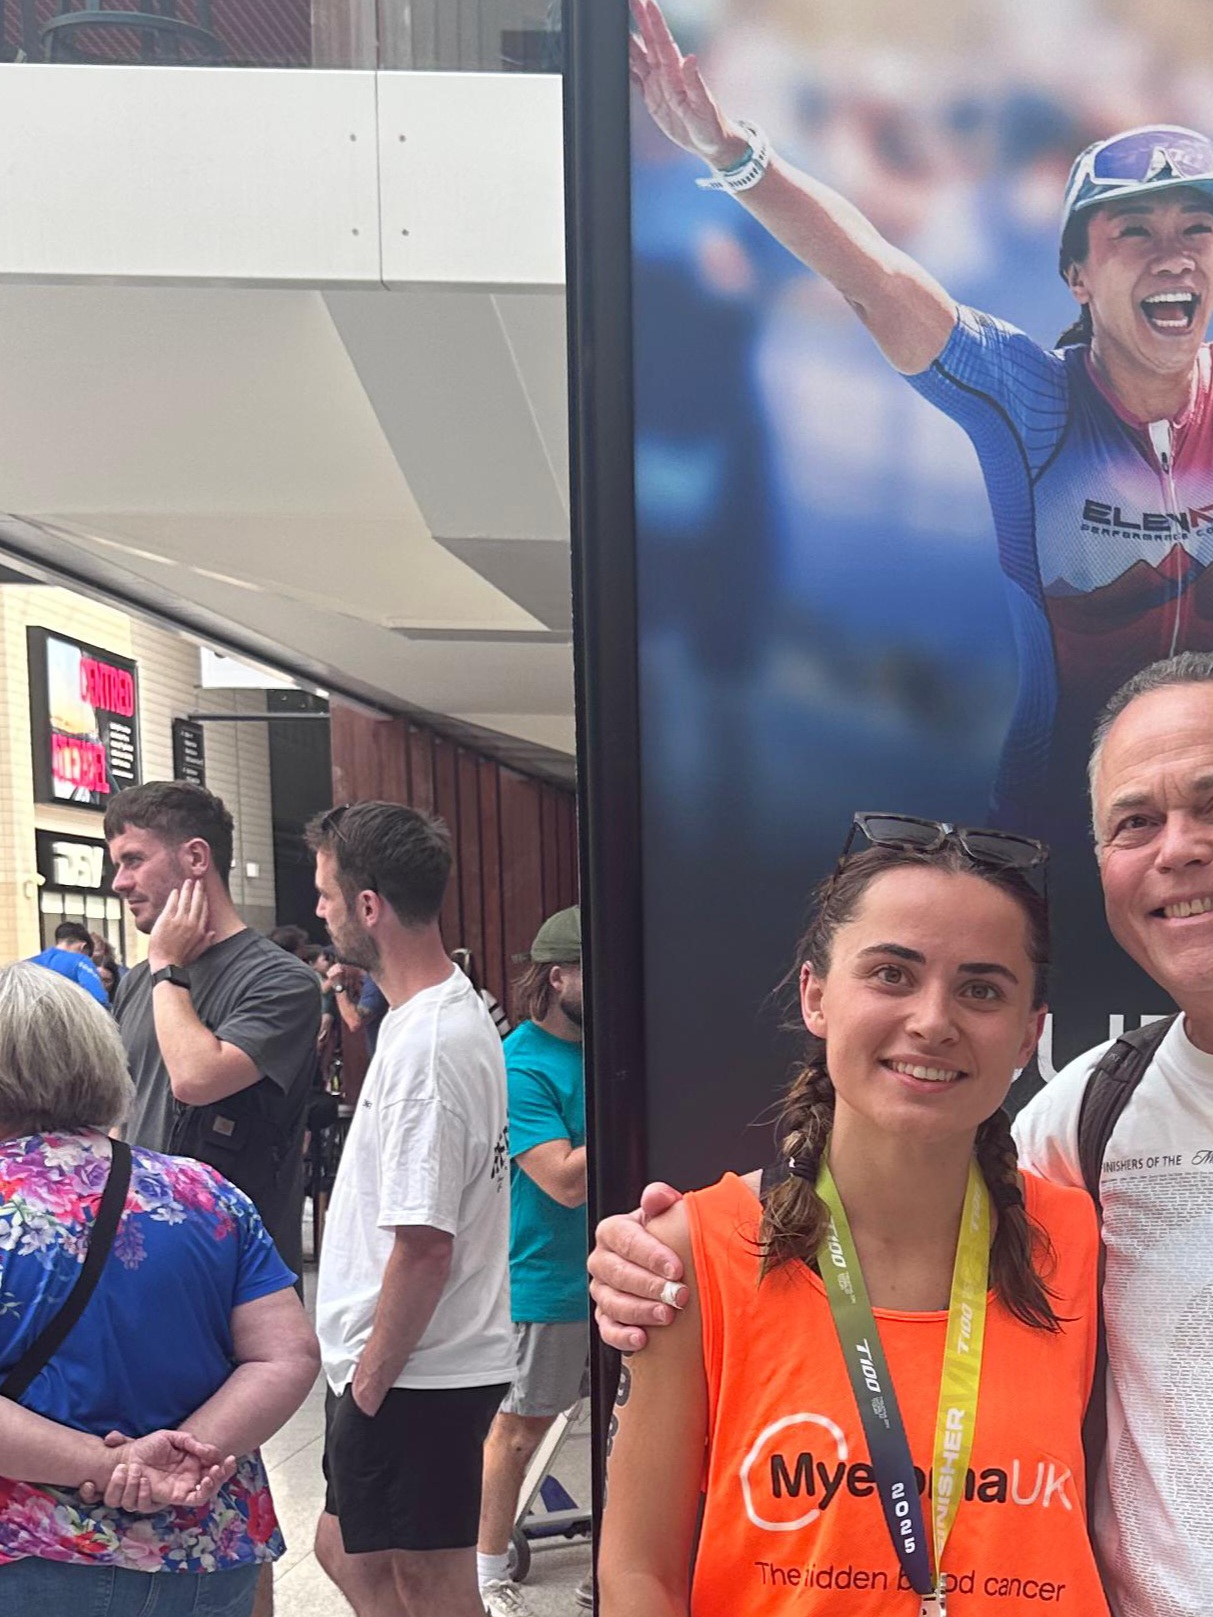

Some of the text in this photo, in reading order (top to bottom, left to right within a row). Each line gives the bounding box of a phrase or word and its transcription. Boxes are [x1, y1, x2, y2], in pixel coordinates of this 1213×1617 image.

[1080, 523, 1188, 542] PERFORMANCE
[1101, 1157, 1143, 1174] INISHERS
[1146, 1156, 1160, 1169] OF
[1163, 1154, 1182, 1167] THE
[957, 1302, 973, 1355] T100
[856, 1338, 881, 1393] T100
[891, 1482, 916, 1555] 2025
[754, 1561, 801, 1587] The
[983, 1576, 1067, 1603] cancer
